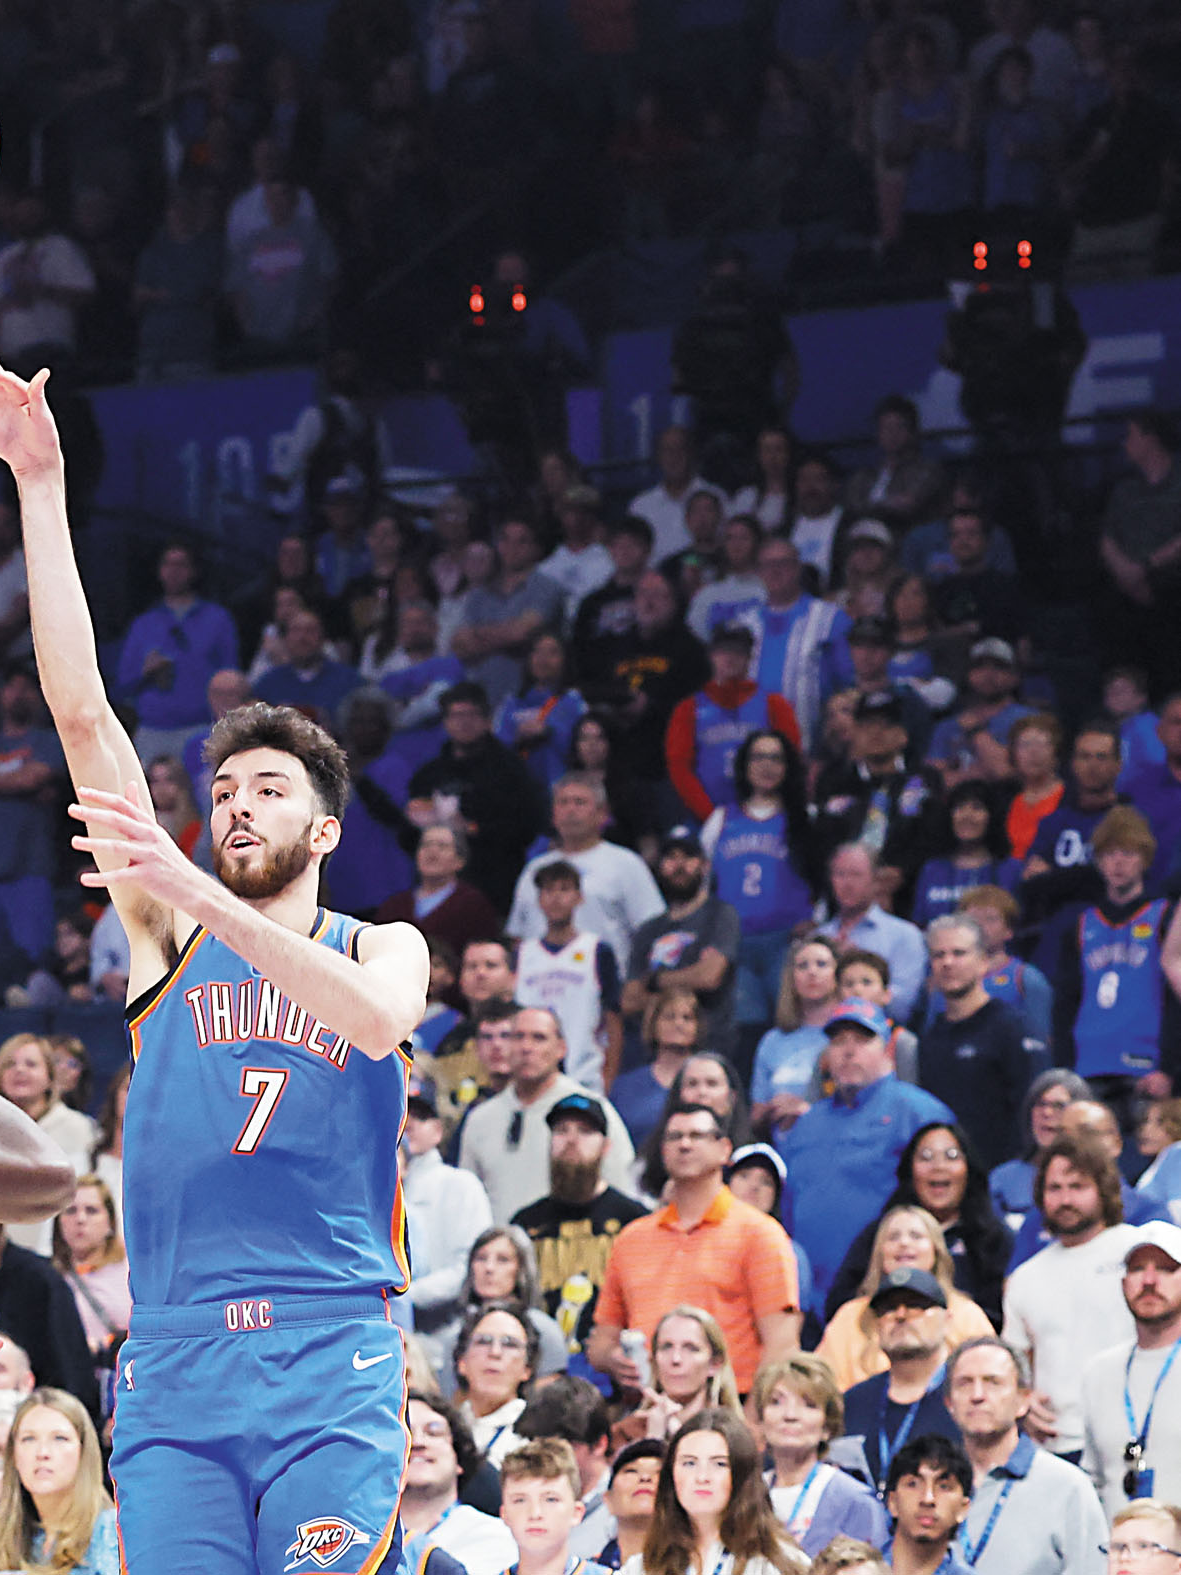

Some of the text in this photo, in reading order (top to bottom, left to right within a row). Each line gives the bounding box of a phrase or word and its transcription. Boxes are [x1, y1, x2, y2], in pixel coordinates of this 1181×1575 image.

[230, 1066, 290, 1156] 7
[224, 1300, 273, 1331] OKC
[297, 1527, 344, 1559] OKC
